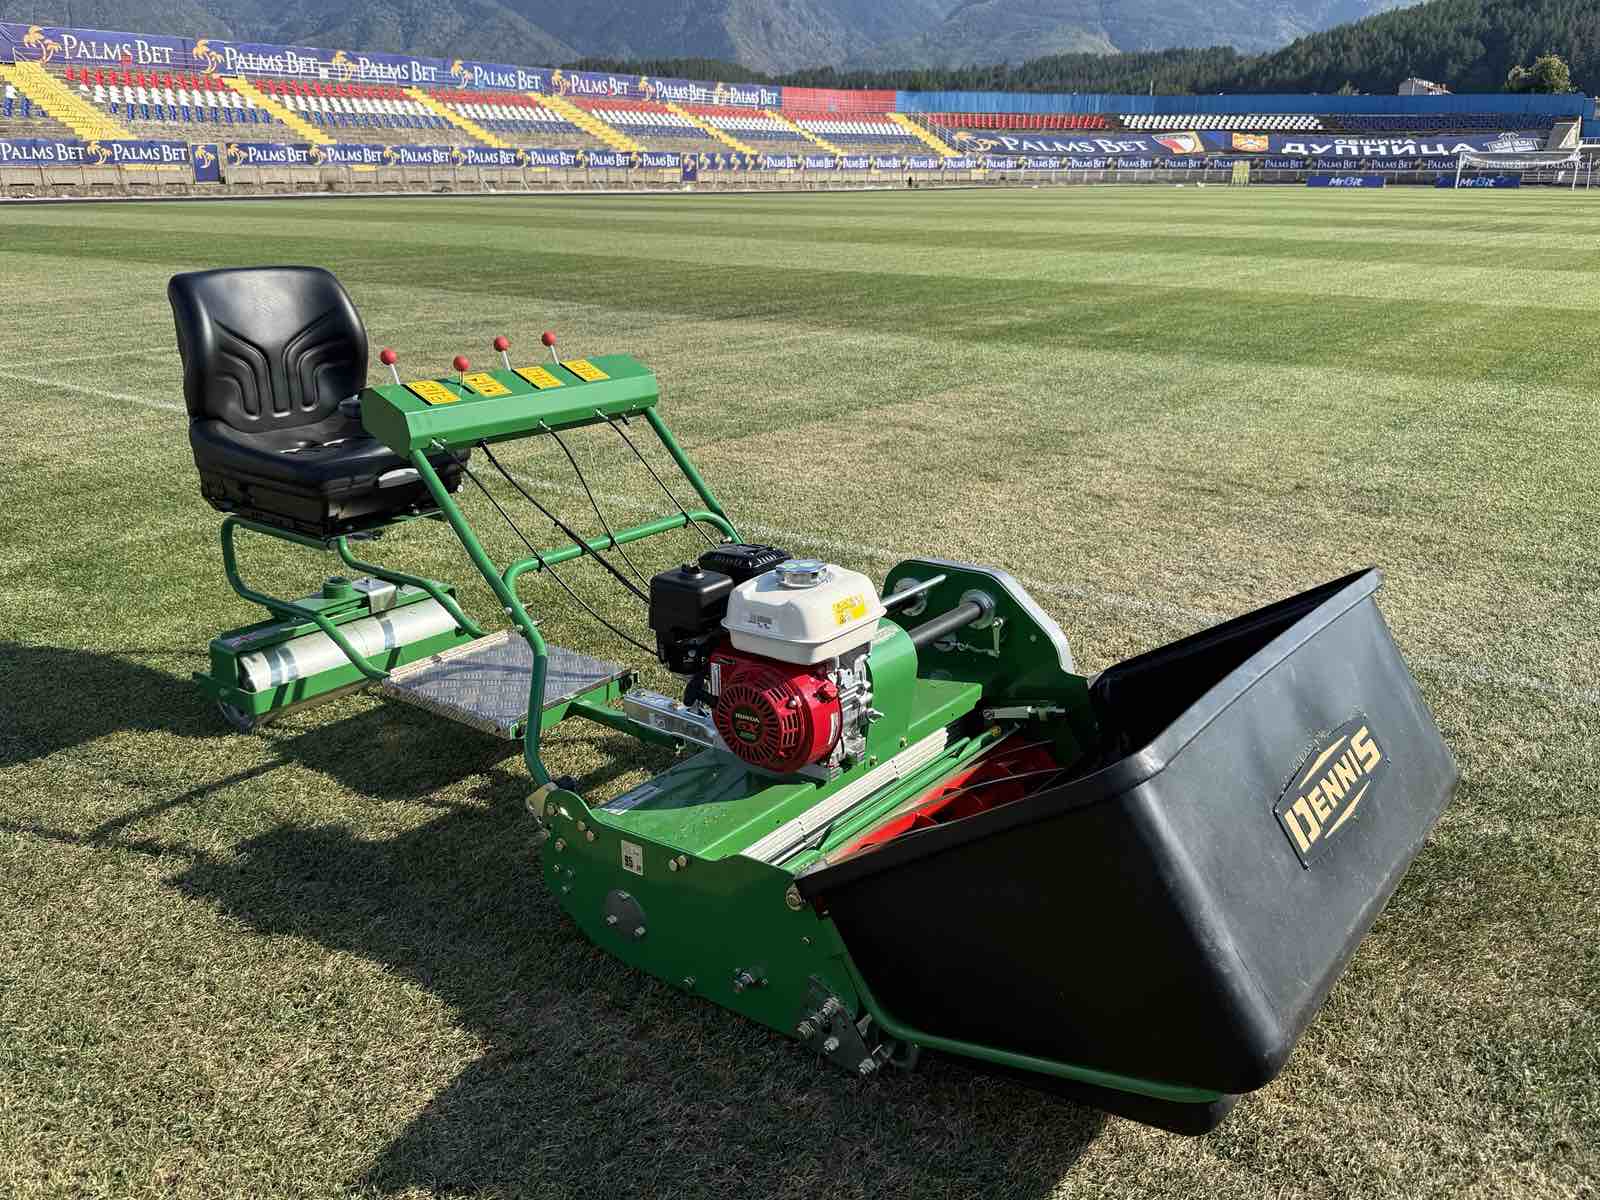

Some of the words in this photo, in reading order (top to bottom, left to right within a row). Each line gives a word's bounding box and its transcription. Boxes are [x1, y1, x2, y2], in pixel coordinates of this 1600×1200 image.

[0, 143, 53, 161] PALMS
[55, 144, 84, 161] BET
[112, 143, 160, 161] PALMS
[161, 144, 187, 162] BET
[1281, 142, 1479, 155] ДУПНИЦА
[1284, 726, 1381, 853] DENNIS
